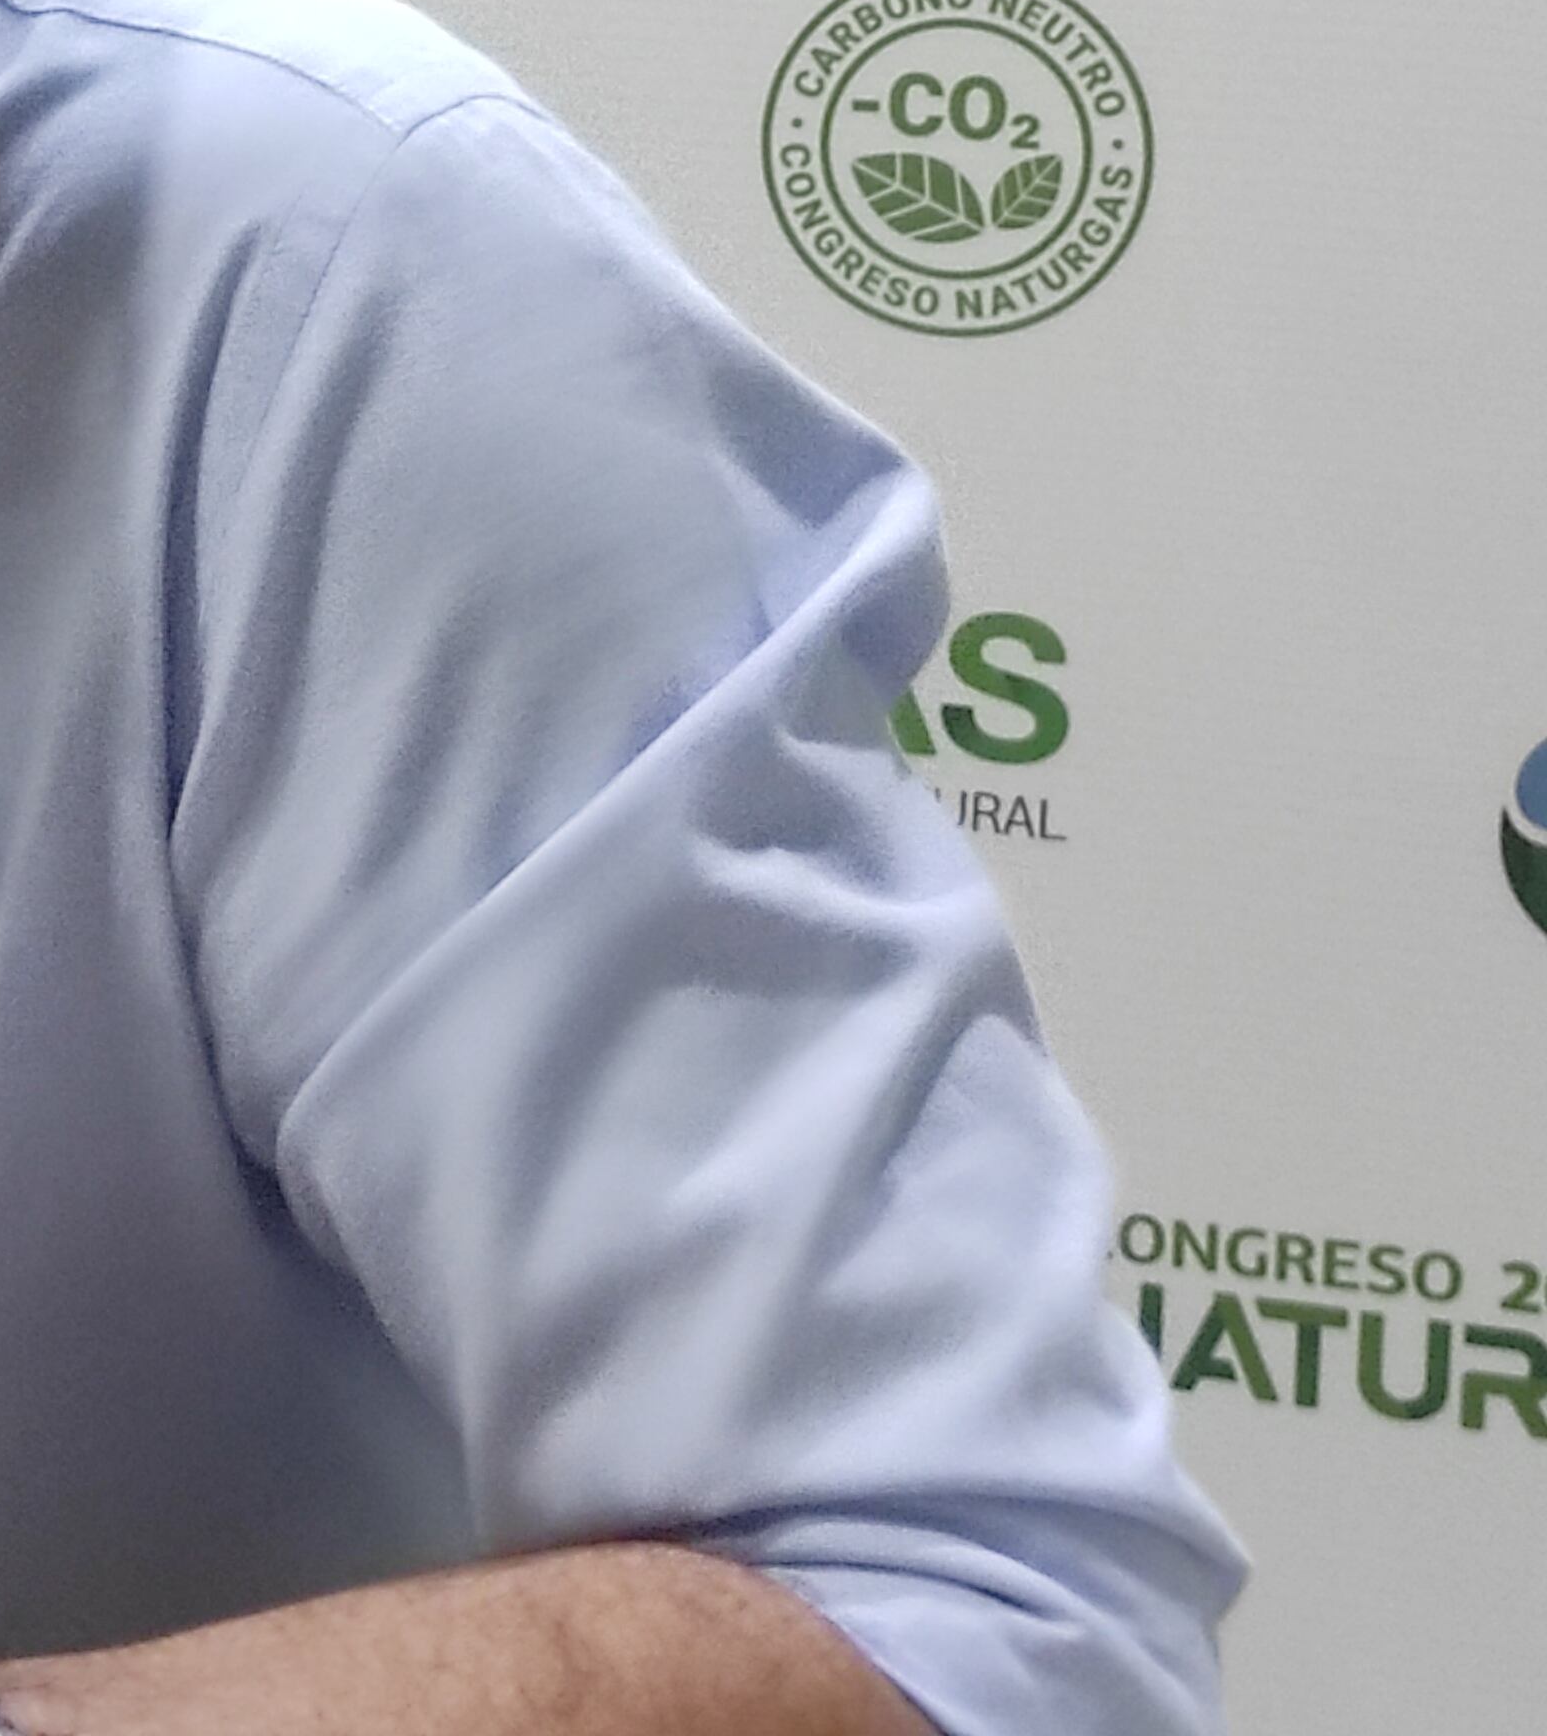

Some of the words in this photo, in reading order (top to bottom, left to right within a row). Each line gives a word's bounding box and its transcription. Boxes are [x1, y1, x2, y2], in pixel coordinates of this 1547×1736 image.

[780, 143, 940, 317] CONGRESO
[956, 163, 1134, 320] NATURGAS
[1107, 1214, 1463, 1302] ONGRESO
